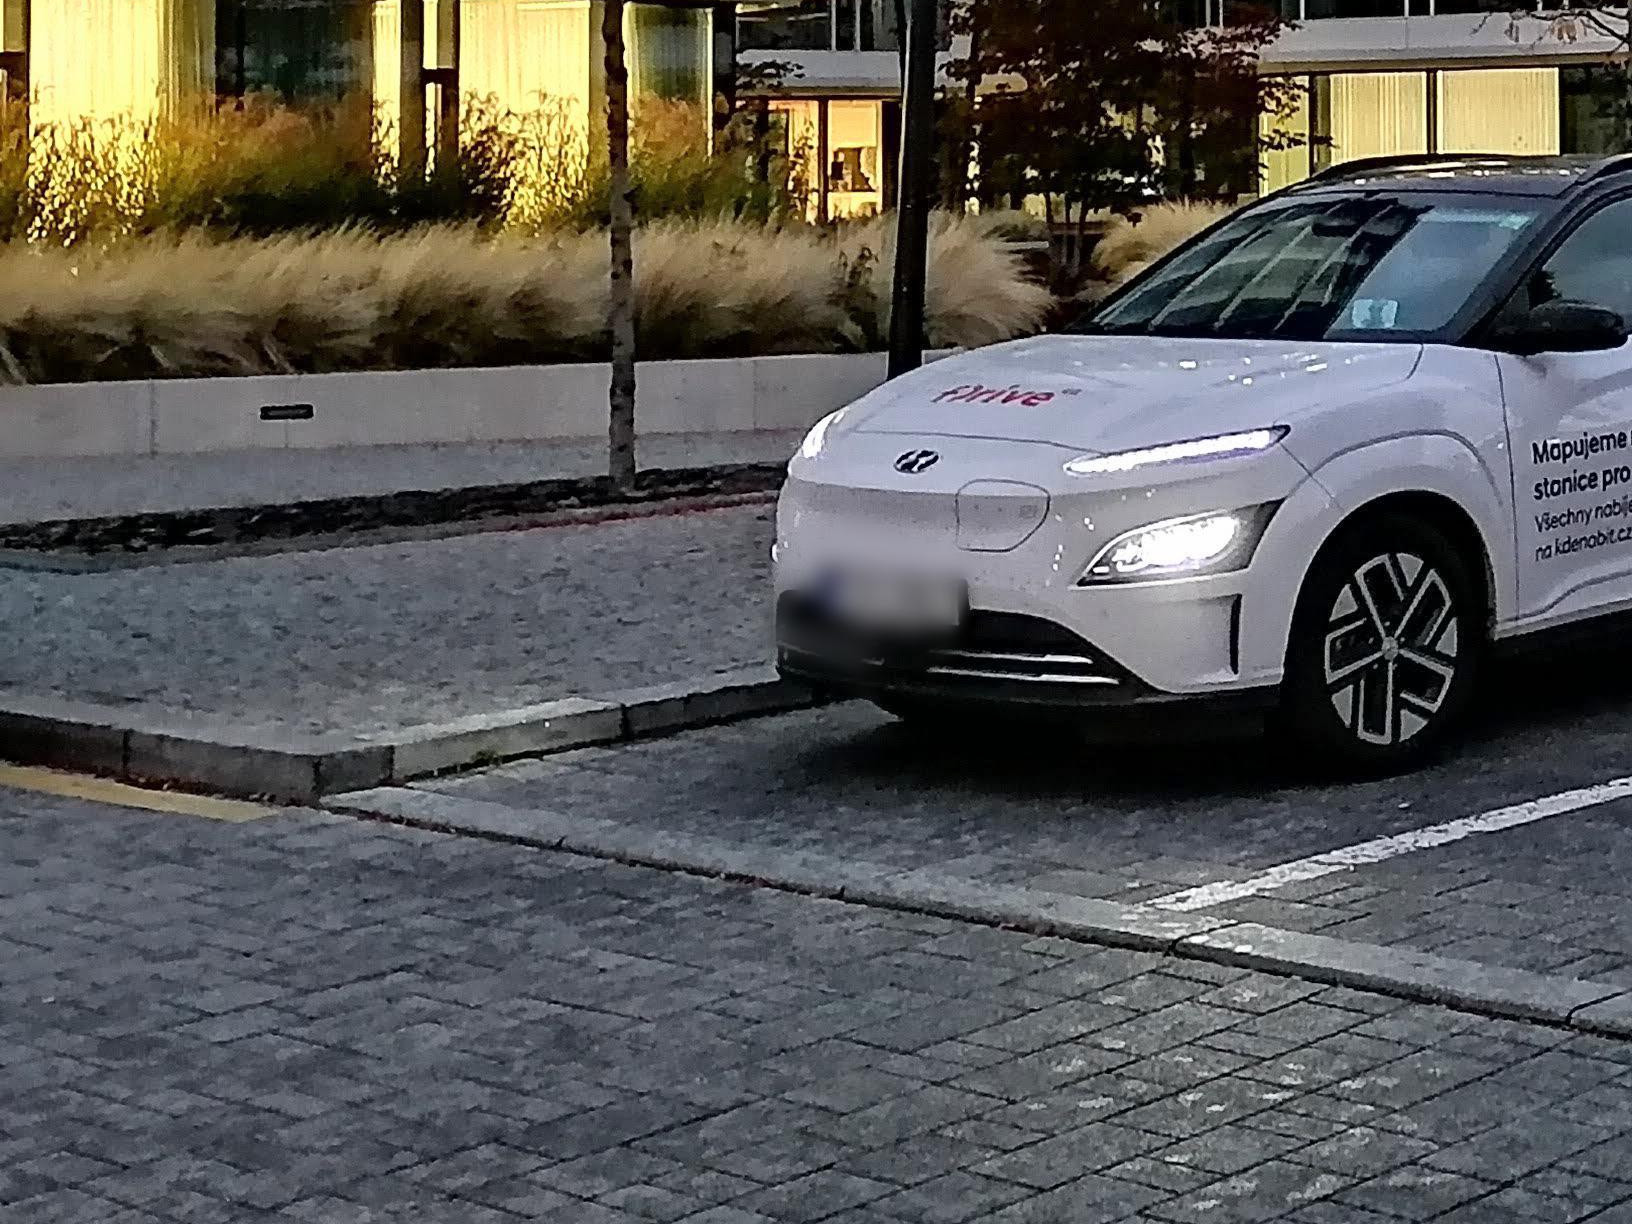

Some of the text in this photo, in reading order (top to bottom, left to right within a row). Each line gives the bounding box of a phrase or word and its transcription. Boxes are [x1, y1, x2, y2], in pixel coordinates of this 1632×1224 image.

[1532, 431, 1628, 465] Mapujeme
[1533, 469, 1599, 501] stanice
[1602, 465, 1631, 492] pro
[1534, 507, 1594, 533] Všechny
[1535, 526, 1632, 562] na kdenabit.cz
